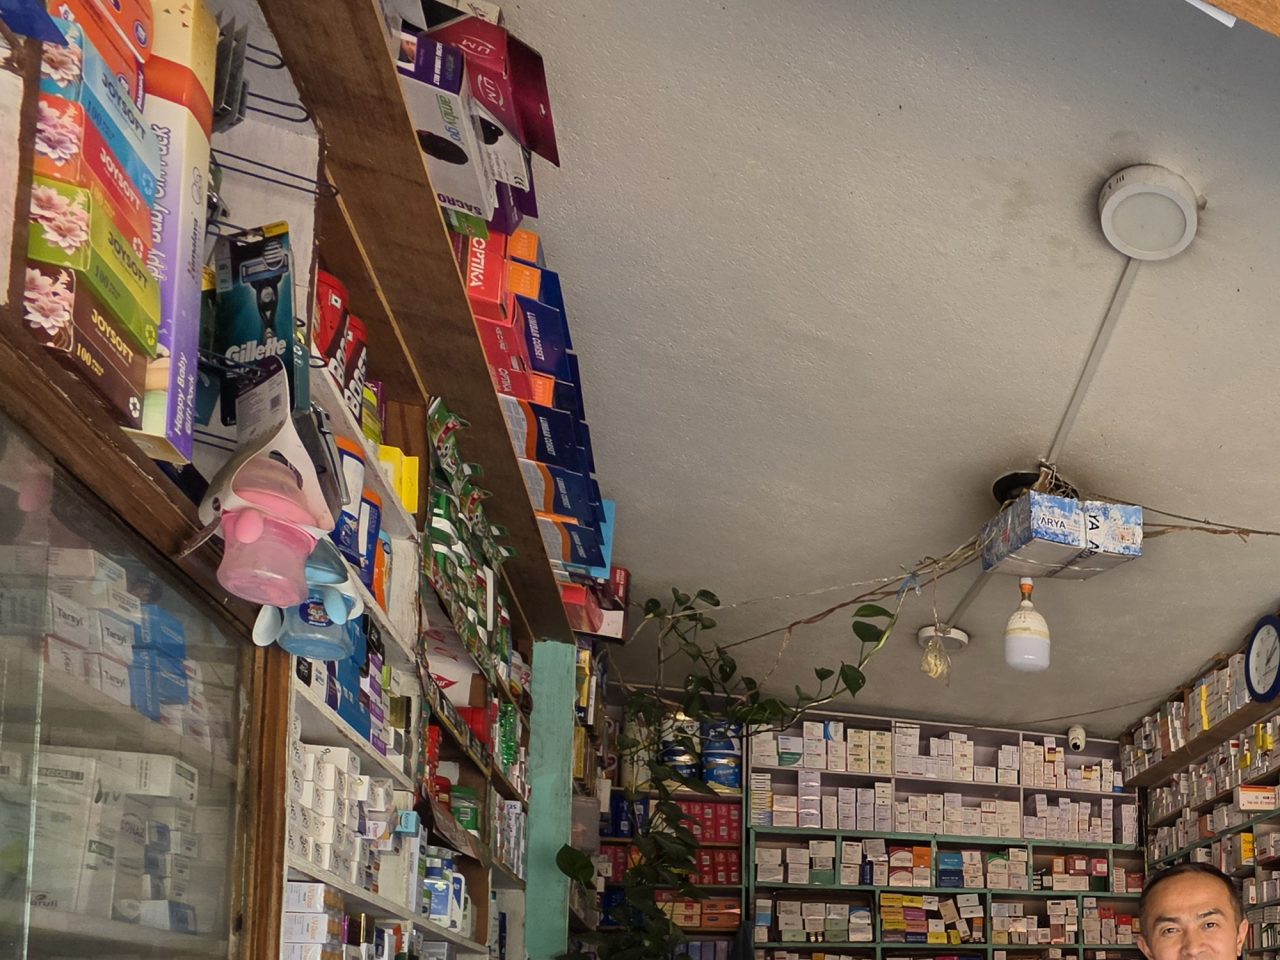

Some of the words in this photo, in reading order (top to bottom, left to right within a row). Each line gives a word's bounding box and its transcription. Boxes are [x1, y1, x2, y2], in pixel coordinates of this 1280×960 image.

[101, 70, 146, 141] JOYSOFT
[99, 145, 142, 214] JOYSOFT
[437, 193, 483, 217] SACRO
[108, 230, 149, 290] JOYSOFT
[470, 236, 487, 289] OPTIKA
[75, 340, 93, 368] 100
[90, 308, 134, 365] JOYSOFT
[225, 336, 288, 365] Gillette
[526, 311, 538, 334] LUMBAR
[532, 335, 544, 361] CORSET
[176, 352, 188, 385] Baby
[498, 367, 511, 394] OPTIKA
[173, 384, 186, 438] Happy
[539, 416, 549, 436] LUMBAR
[544, 437, 556, 457] CORSET
